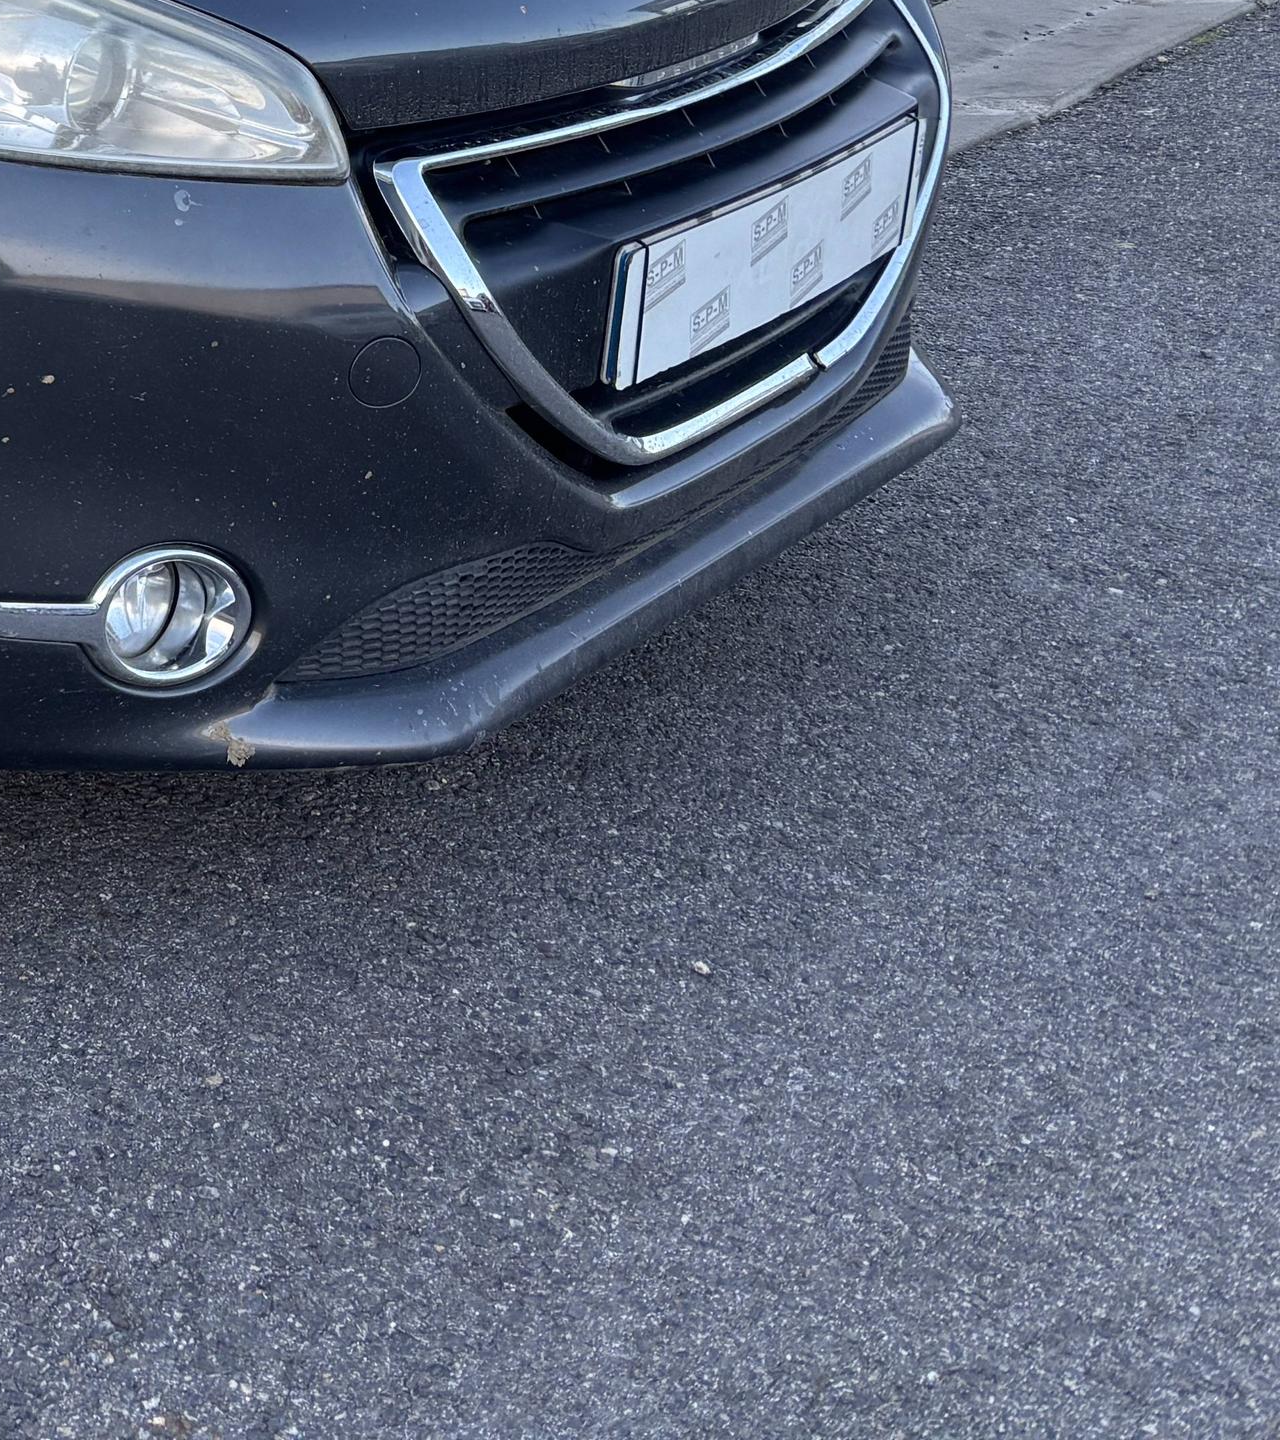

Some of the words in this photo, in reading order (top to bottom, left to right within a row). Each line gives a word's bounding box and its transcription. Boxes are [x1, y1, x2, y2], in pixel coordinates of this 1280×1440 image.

[843, 158, 871, 197] S-P-M
[754, 202, 786, 241] S-P-M
[874, 201, 900, 239] S-P-M
[646, 247, 683, 287] S-P-M
[792, 245, 822, 285] S-P-M
[692, 293, 728, 333] S-P-M
